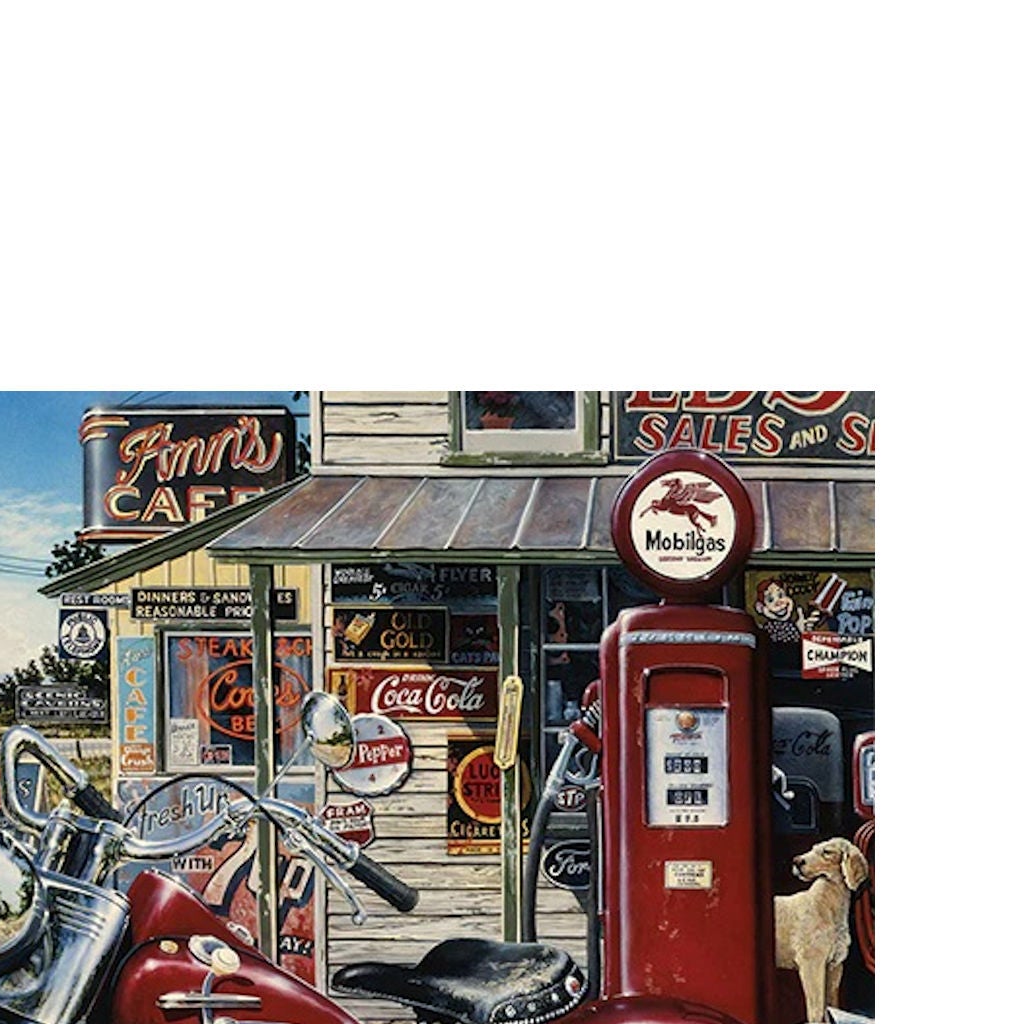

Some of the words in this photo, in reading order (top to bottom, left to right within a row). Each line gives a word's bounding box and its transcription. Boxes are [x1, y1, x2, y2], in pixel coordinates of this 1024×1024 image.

[632, 413, 785, 456] SALES
[789, 424, 828, 450] AND
[116, 414, 283, 486] Ann's
[645, 529, 726, 556] Mobilgas
[137, 590, 196, 604] DINNERS
[136, 606, 217, 618] REASONABLE
[391, 612, 430, 631] OLD
[380, 629, 433, 650] GOLD
[807, 649, 868, 662] CHAMPION
[124, 667, 148, 744] CAFE
[358, 744, 404, 764] Pepper
[557, 789, 585, 806] STP
[326, 804, 366, 817] FRAM
[173, 856, 214, 870] WITH
[549, 849, 591, 876] For
